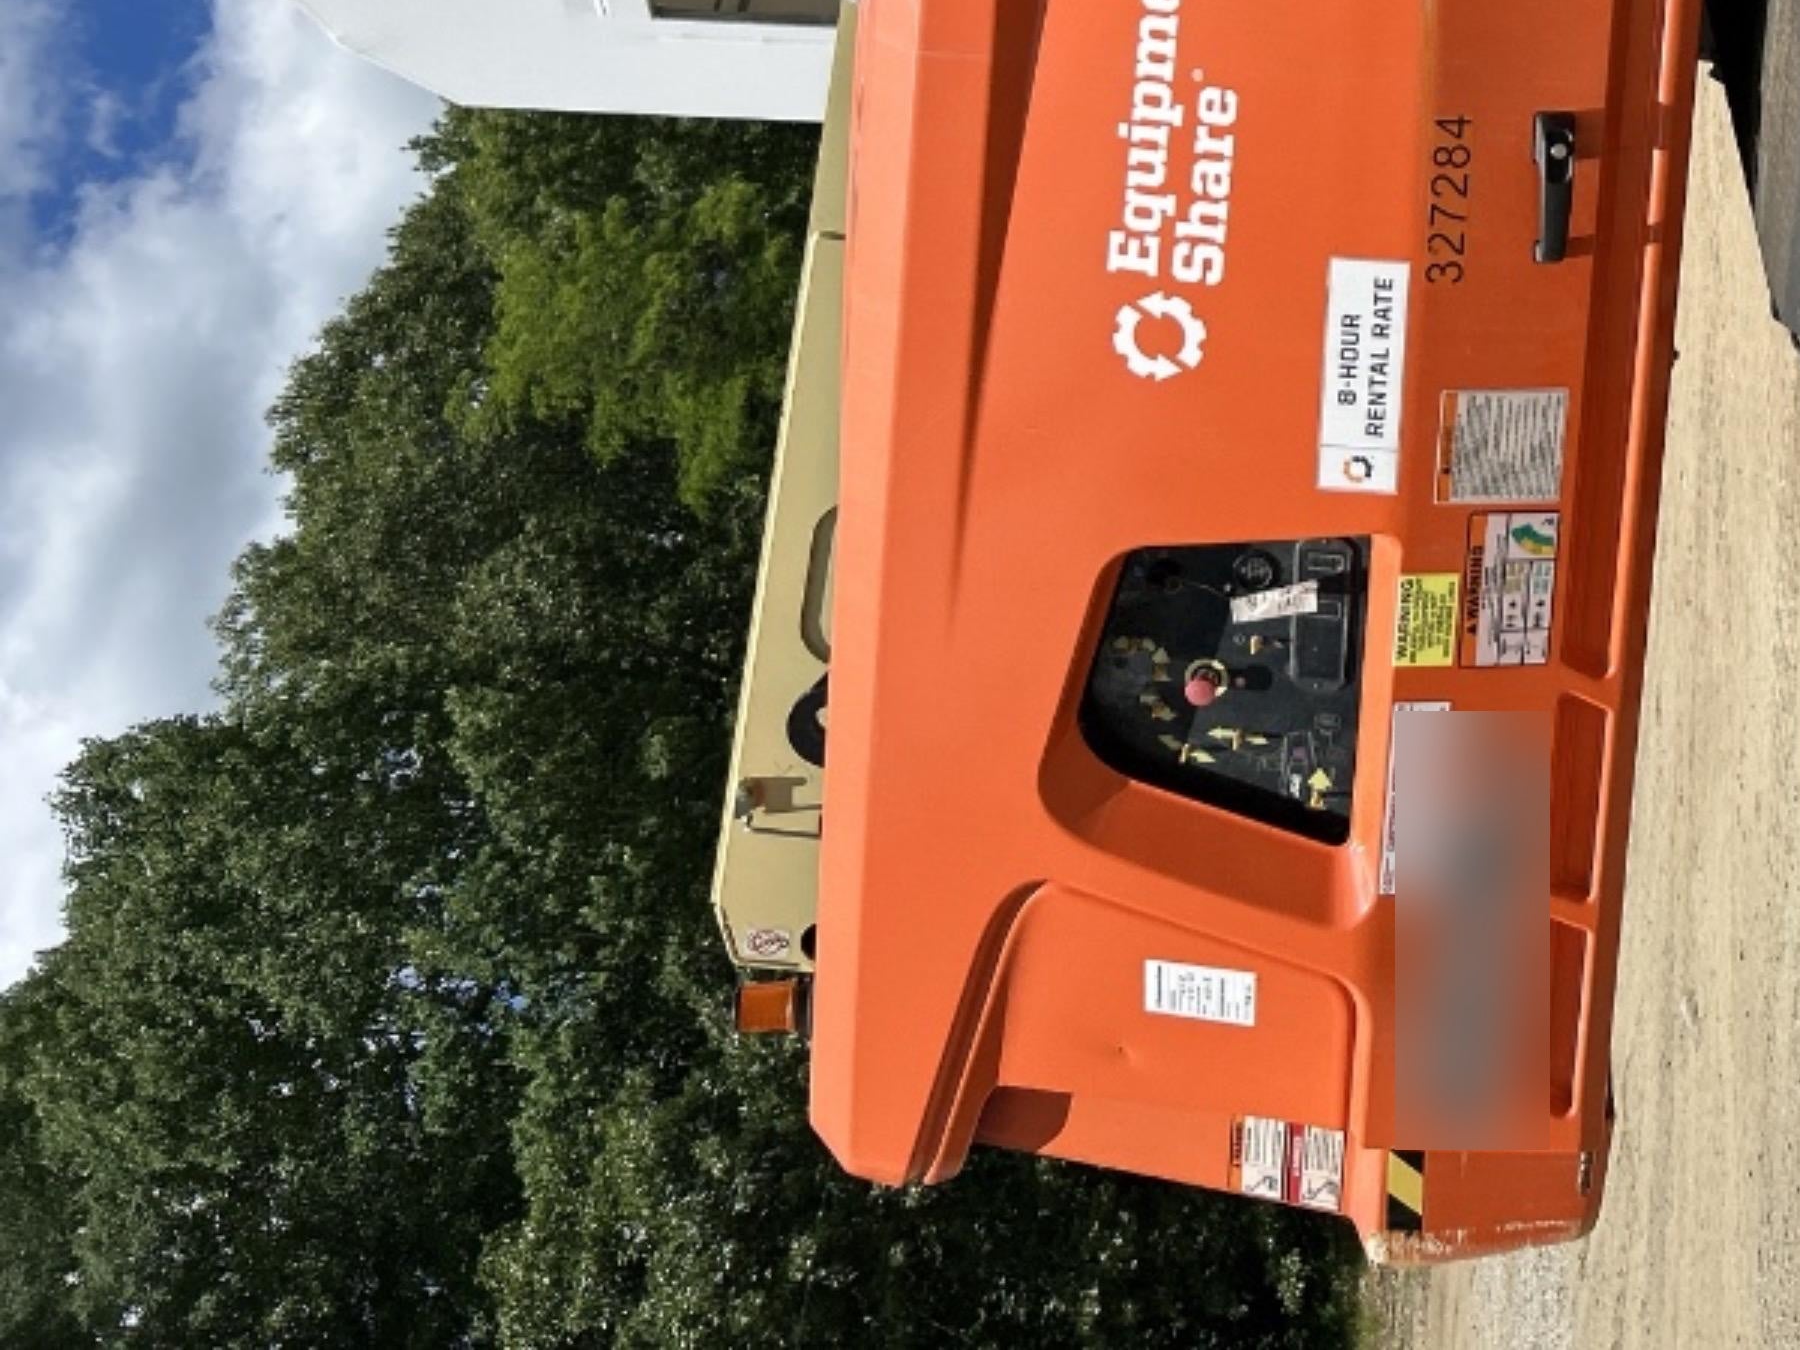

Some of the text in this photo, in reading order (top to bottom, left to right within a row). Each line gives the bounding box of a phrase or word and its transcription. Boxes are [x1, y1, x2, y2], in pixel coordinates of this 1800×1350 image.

[1171, 85, 1239, 285] Share
[1425, 113, 1473, 284] 327284
[1337, 312, 1362, 405] 8-HOUR
[1365, 276, 1394, 438] RENTAL RATE
[1396, 578, 1413, 660] WARNING
[1466, 544, 1484, 618] WARNING
